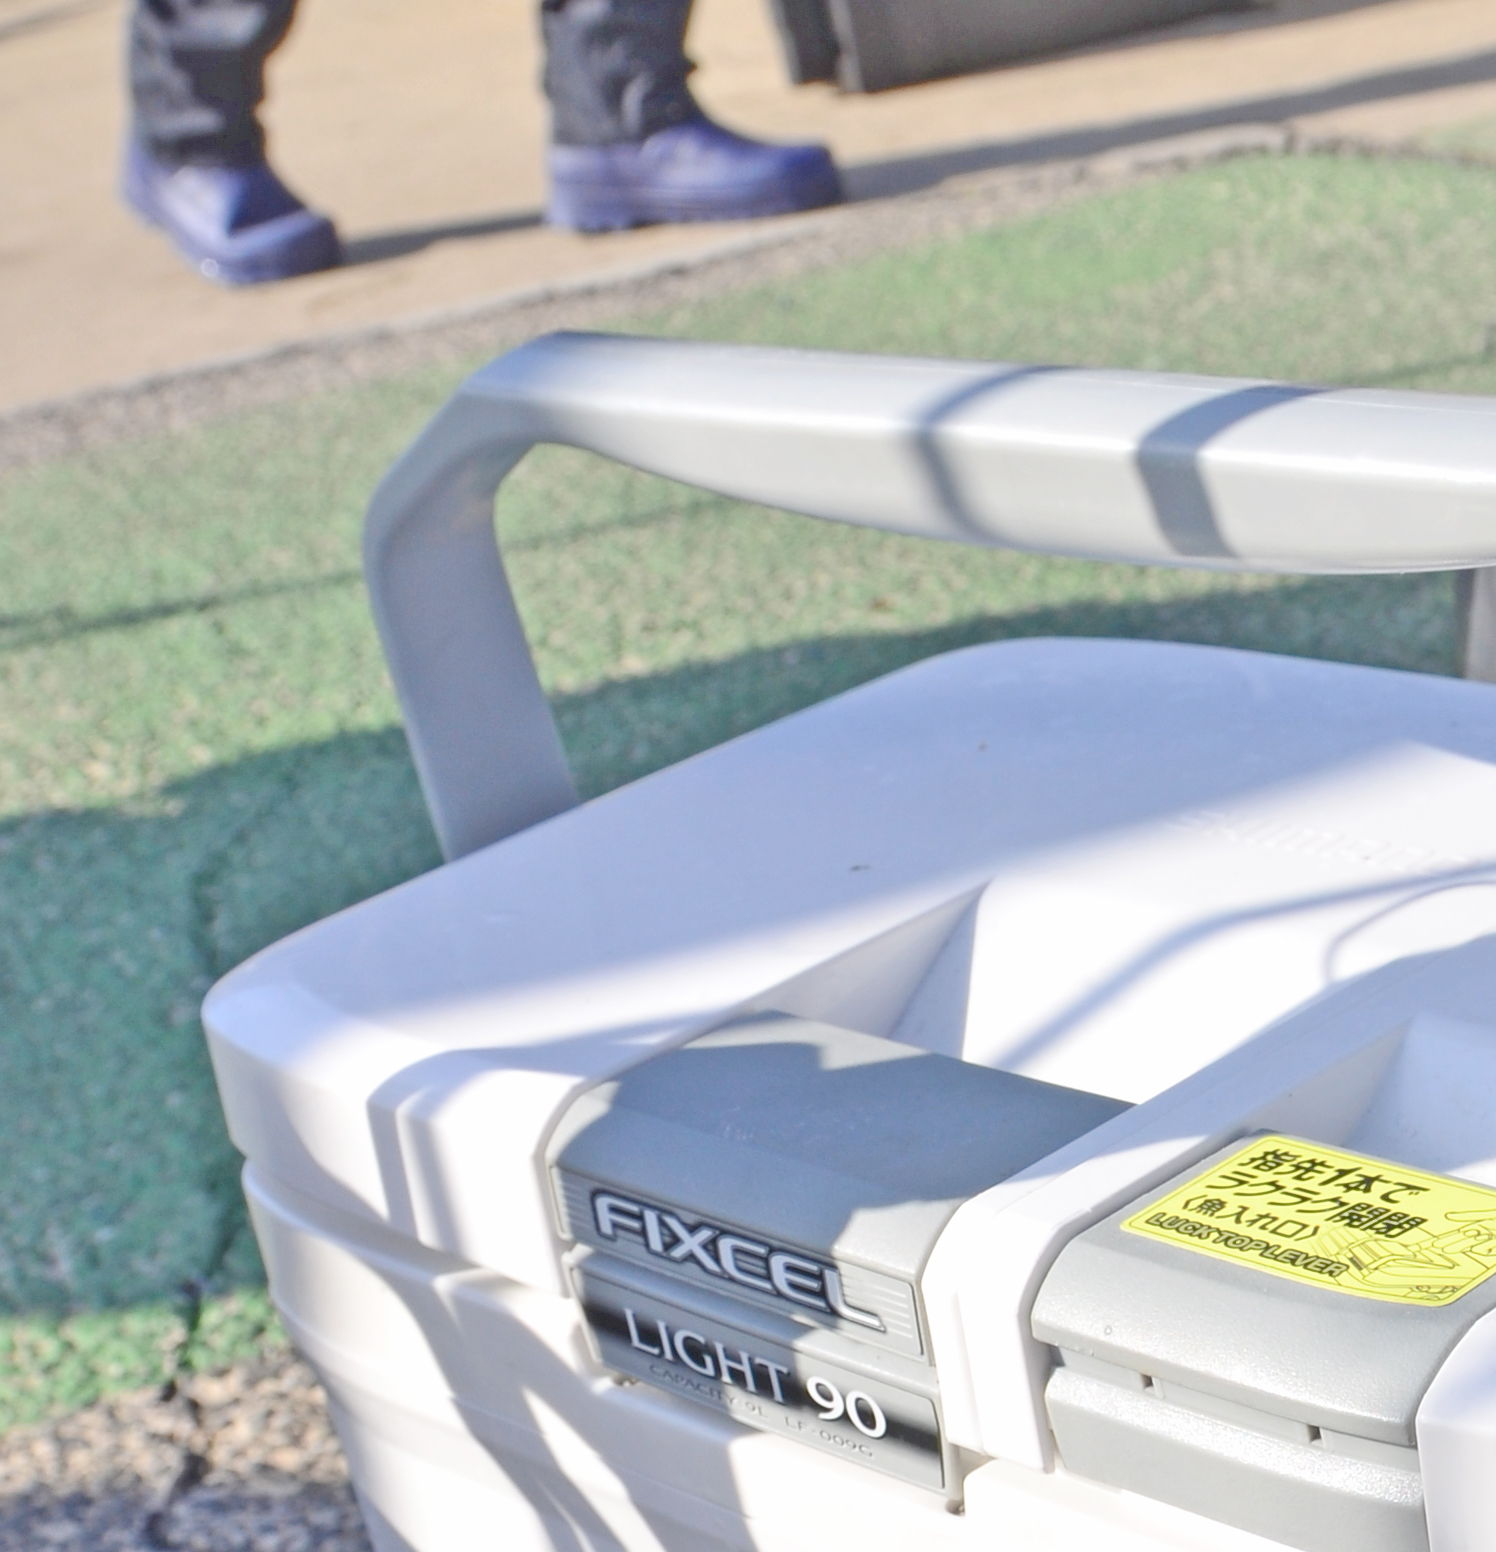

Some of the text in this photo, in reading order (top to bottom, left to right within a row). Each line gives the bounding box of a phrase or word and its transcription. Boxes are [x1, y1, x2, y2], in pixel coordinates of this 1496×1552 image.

[1206, 1170, 1429, 1239] ラクラク開閉
[1238, 1148, 1431, 1206] 指先1本で
[1144, 1212, 1218, 1239] LUCK
[591, 1190, 886, 1332] FIXCEL
[623, 1308, 887, 1439] LIGHT 90
